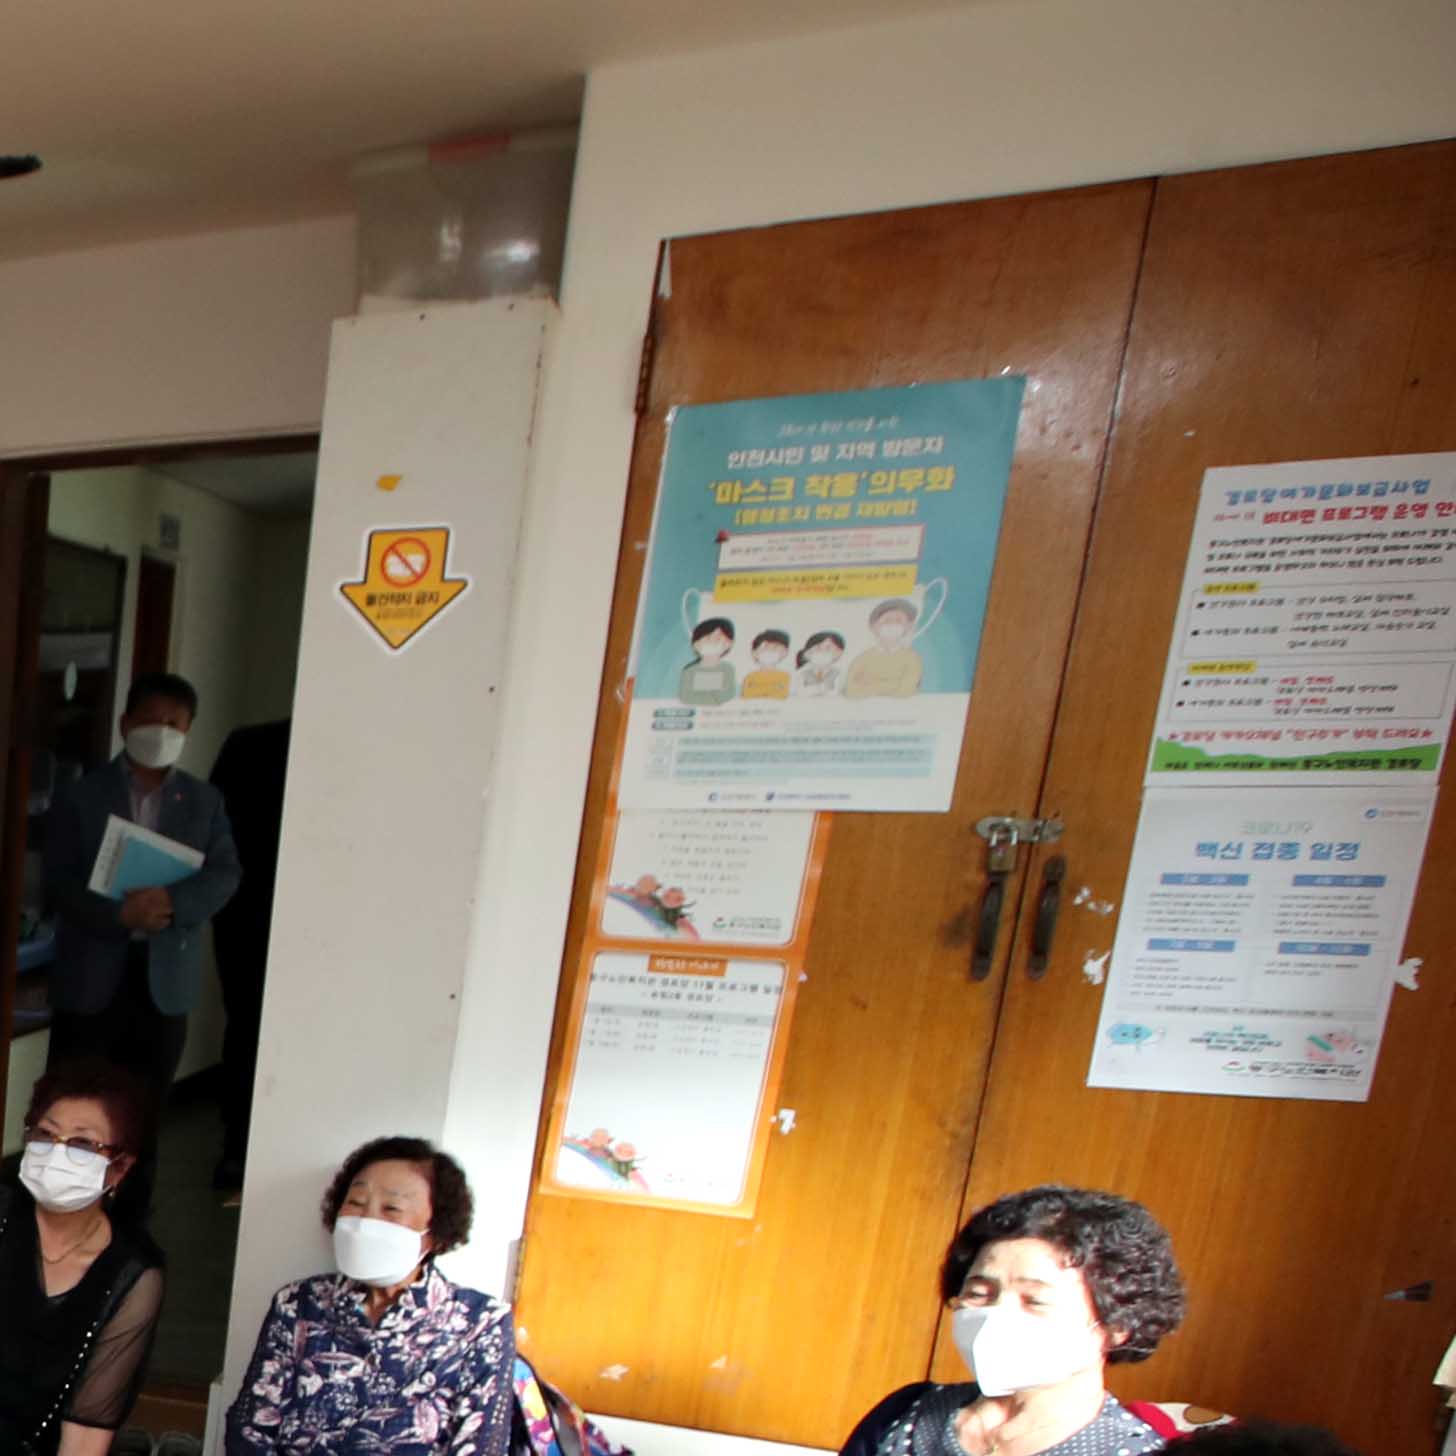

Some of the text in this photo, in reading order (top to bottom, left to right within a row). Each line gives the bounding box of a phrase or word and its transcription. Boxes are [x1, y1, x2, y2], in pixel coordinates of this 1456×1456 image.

[728, 436, 944, 468] 인천시민 및 지역 방문자
[1262, 508, 1316, 526] 비대면
[1320, 503, 1388, 523] 프로그램
[1393, 502, 1429, 519] 운영
[1434, 500, 1456, 518] 안
[1195, 841, 1361, 862] 백신 접종 일정
